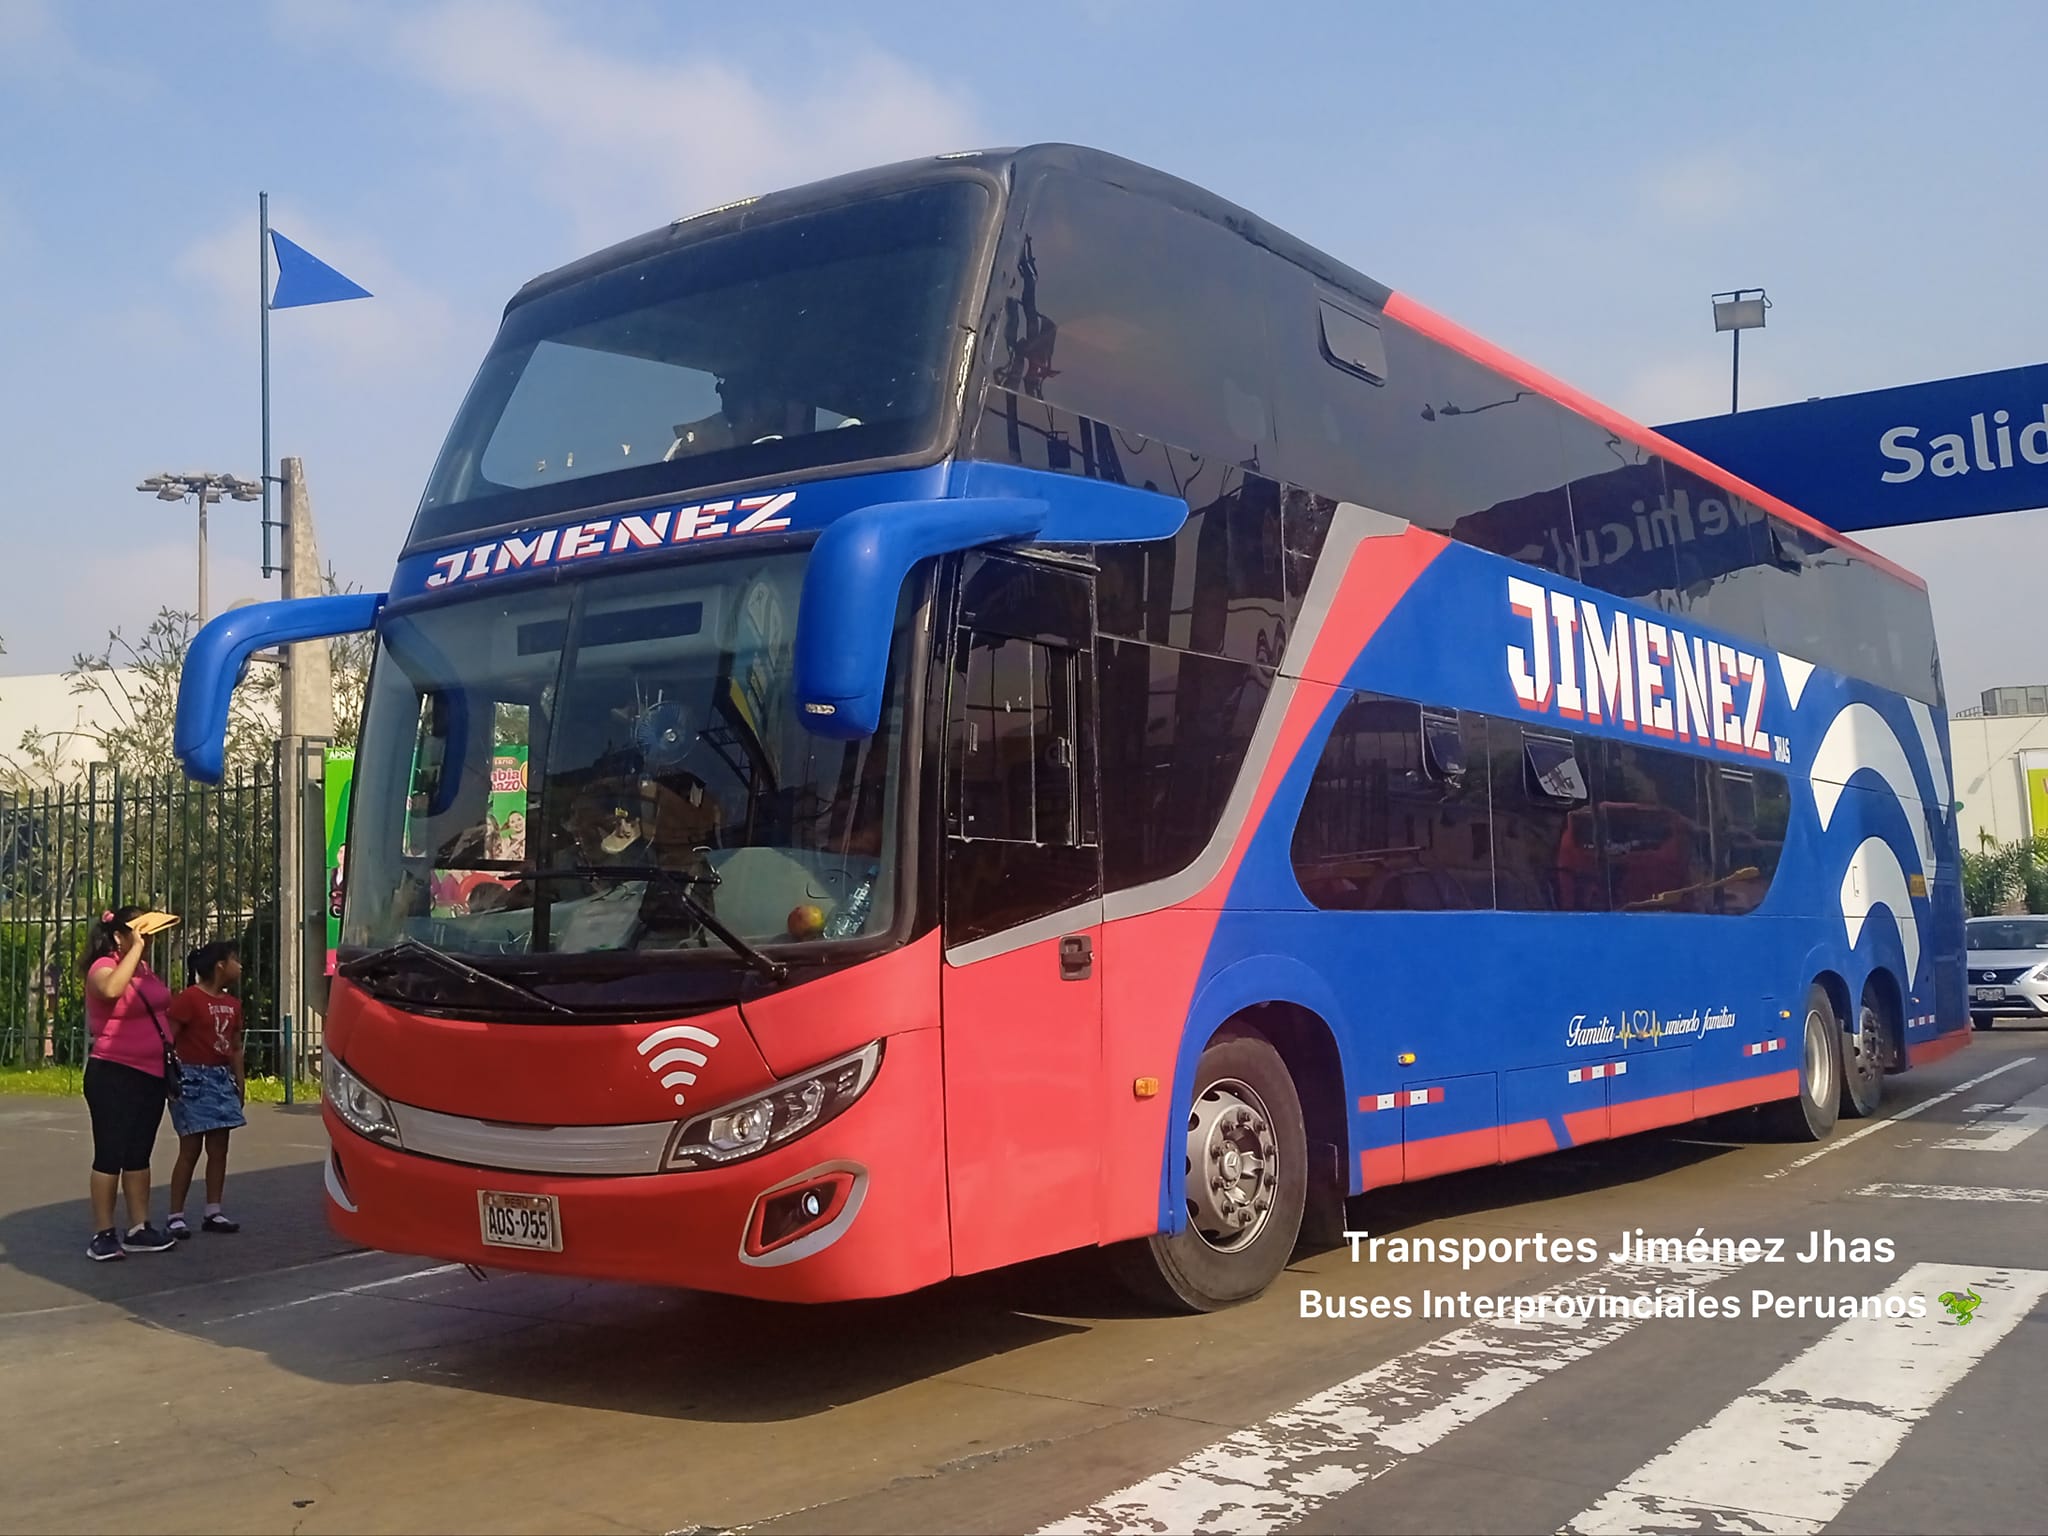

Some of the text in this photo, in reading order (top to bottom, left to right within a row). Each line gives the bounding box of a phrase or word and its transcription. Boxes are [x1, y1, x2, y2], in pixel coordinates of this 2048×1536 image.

[1879, 403, 2048, 484] Salid
[426, 491, 798, 587] JIMENEZ
[1507, 575, 1771, 759] JIMENEZ
[1566, 1006, 1735, 1047] Familia uniendo familias
[489, 1206, 548, 1240] AOS-955
